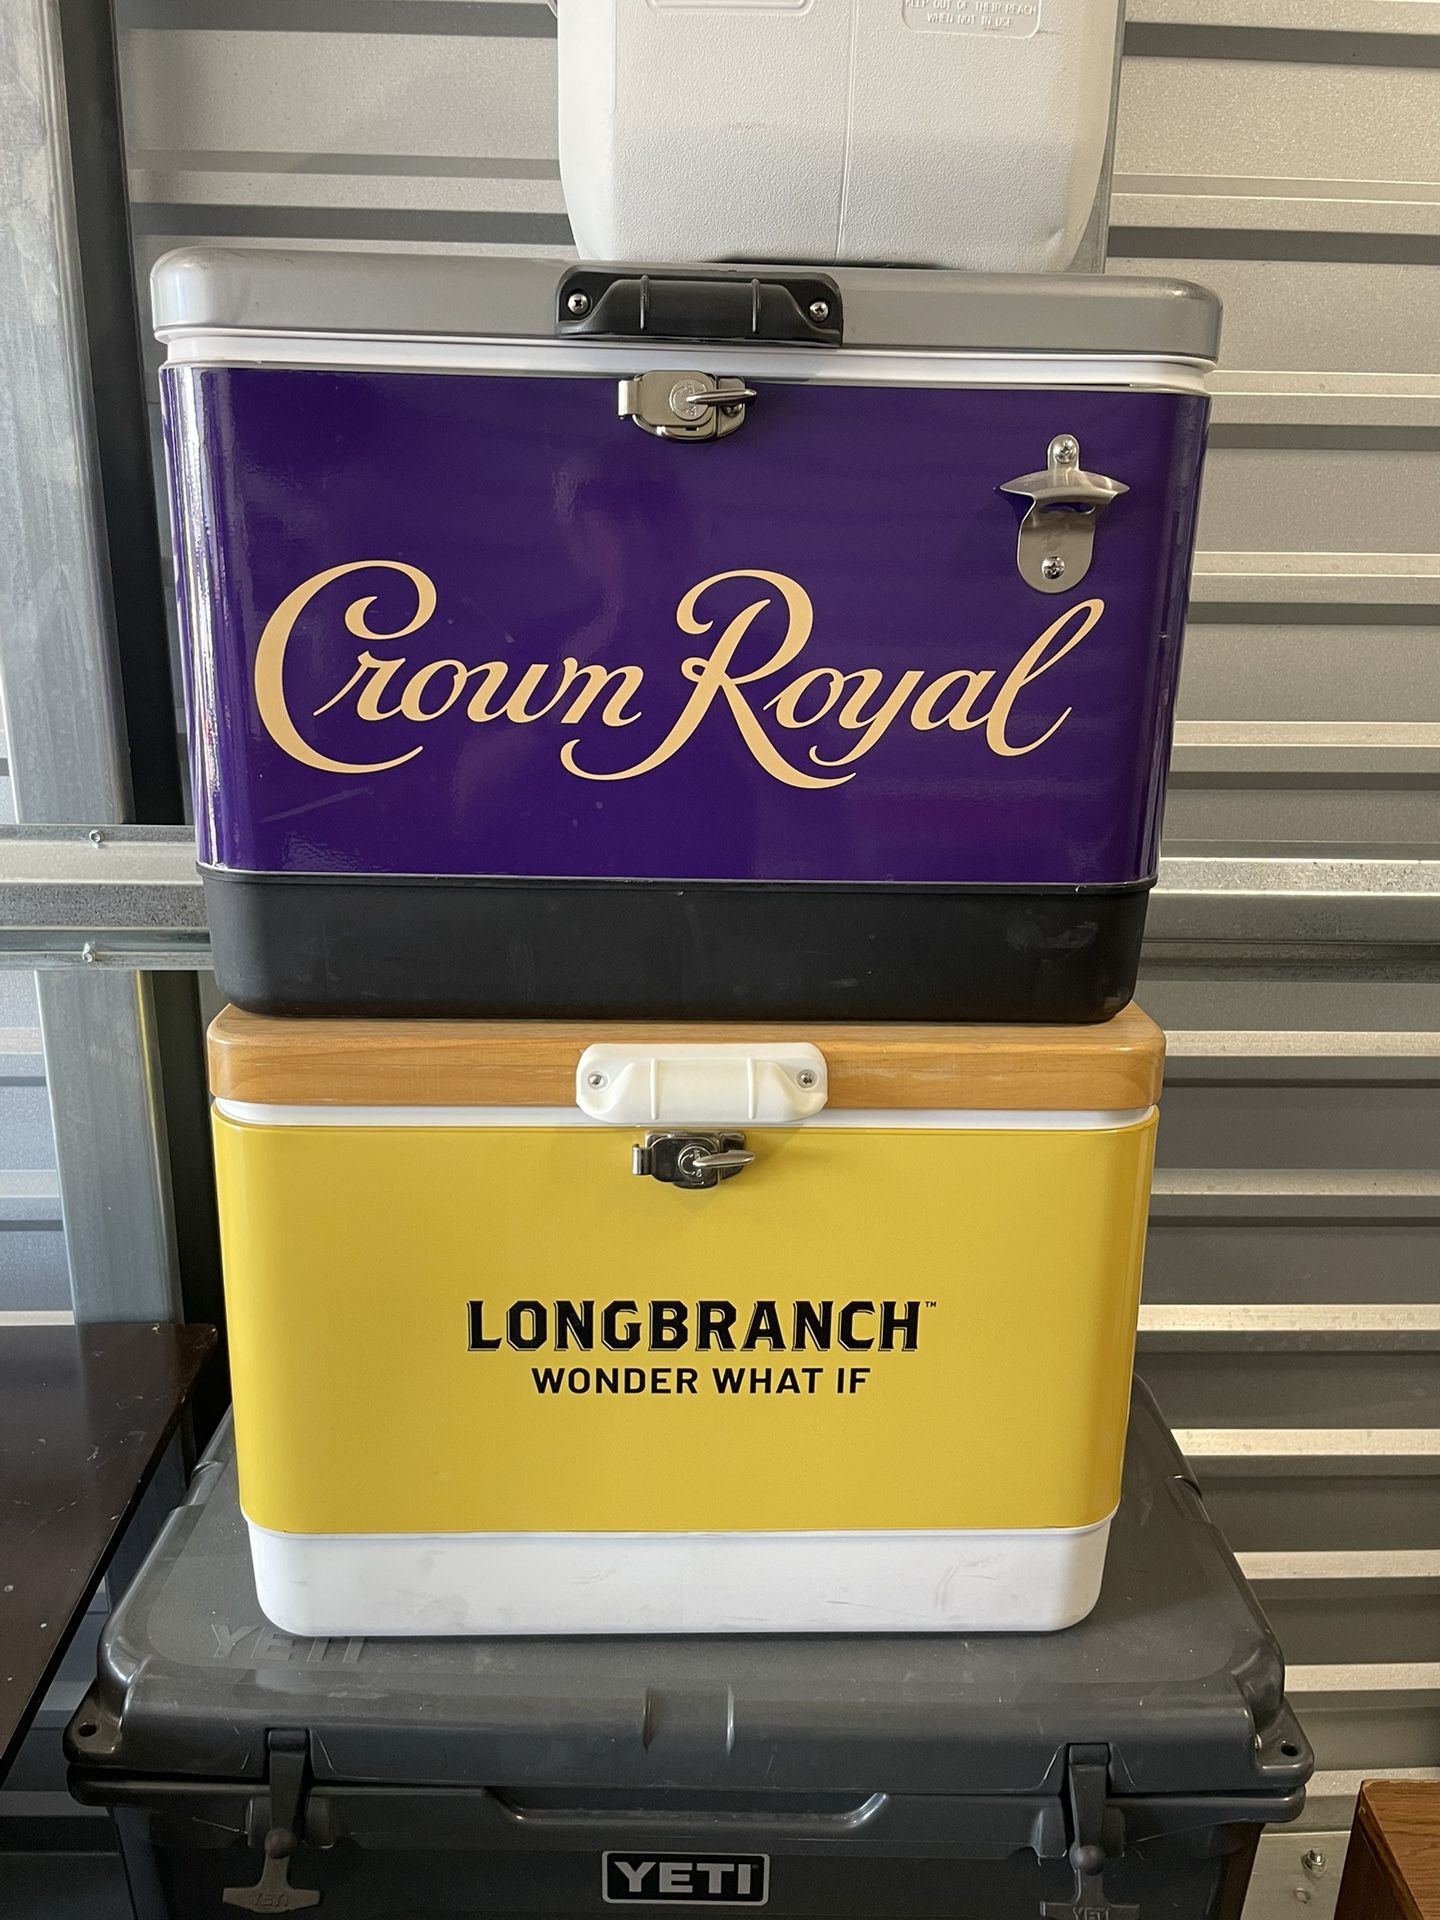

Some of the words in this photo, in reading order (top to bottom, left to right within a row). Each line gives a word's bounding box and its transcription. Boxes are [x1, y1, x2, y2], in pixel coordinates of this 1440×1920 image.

[927, 12, 955, 24] WHEN
[957, 14, 976, 25] NOT
[981, 15, 992, 26] IN
[995, 16, 1013, 27] USE
[933, 0, 951, 10] OUT
[956, 0, 969, 10] OF
[976, 1, 1002, 13] THEIR
[1005, 3, 1037, 15] REACH
[254, 559, 645, 774] Crown
[560, 569, 1105, 789] Royal
[467, 1300, 921, 1352] LONGBRANCH
[531, 1367, 698, 1394] WONDER
[712, 1367, 824, 1394] WHAT
[837, 1367, 871, 1394] IF
[613, 1861, 752, 1895] YETI
